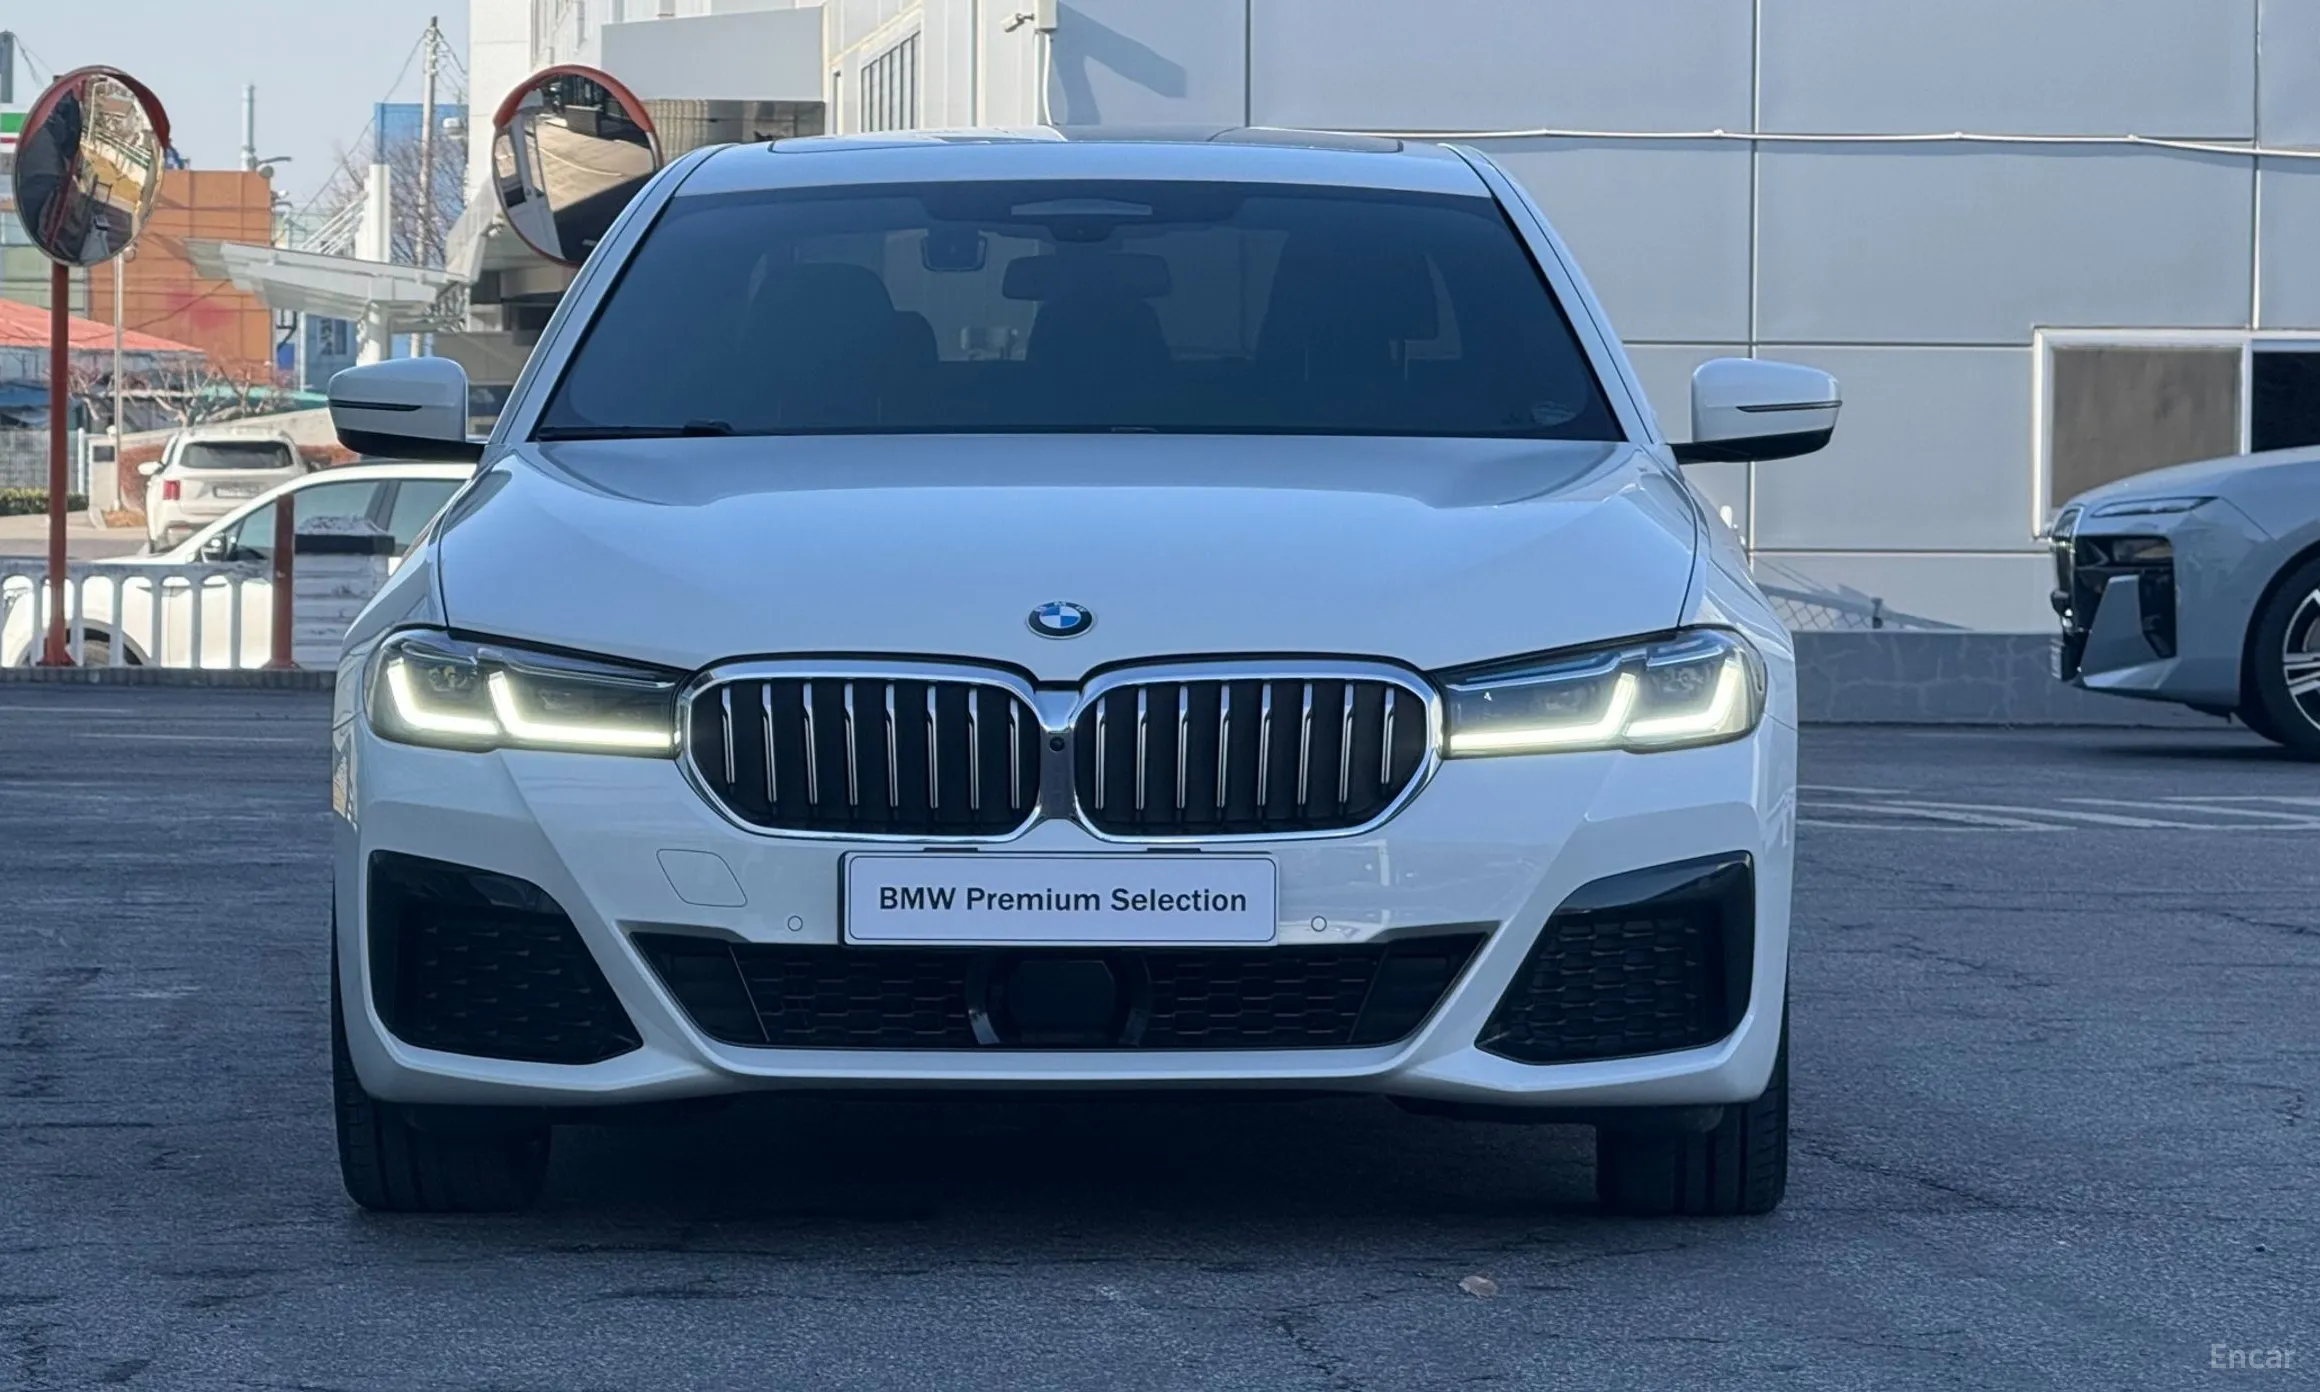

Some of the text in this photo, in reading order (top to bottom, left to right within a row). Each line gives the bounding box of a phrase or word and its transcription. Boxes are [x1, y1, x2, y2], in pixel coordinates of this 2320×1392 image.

[880, 886, 1246, 911] BMW Premium Selection
